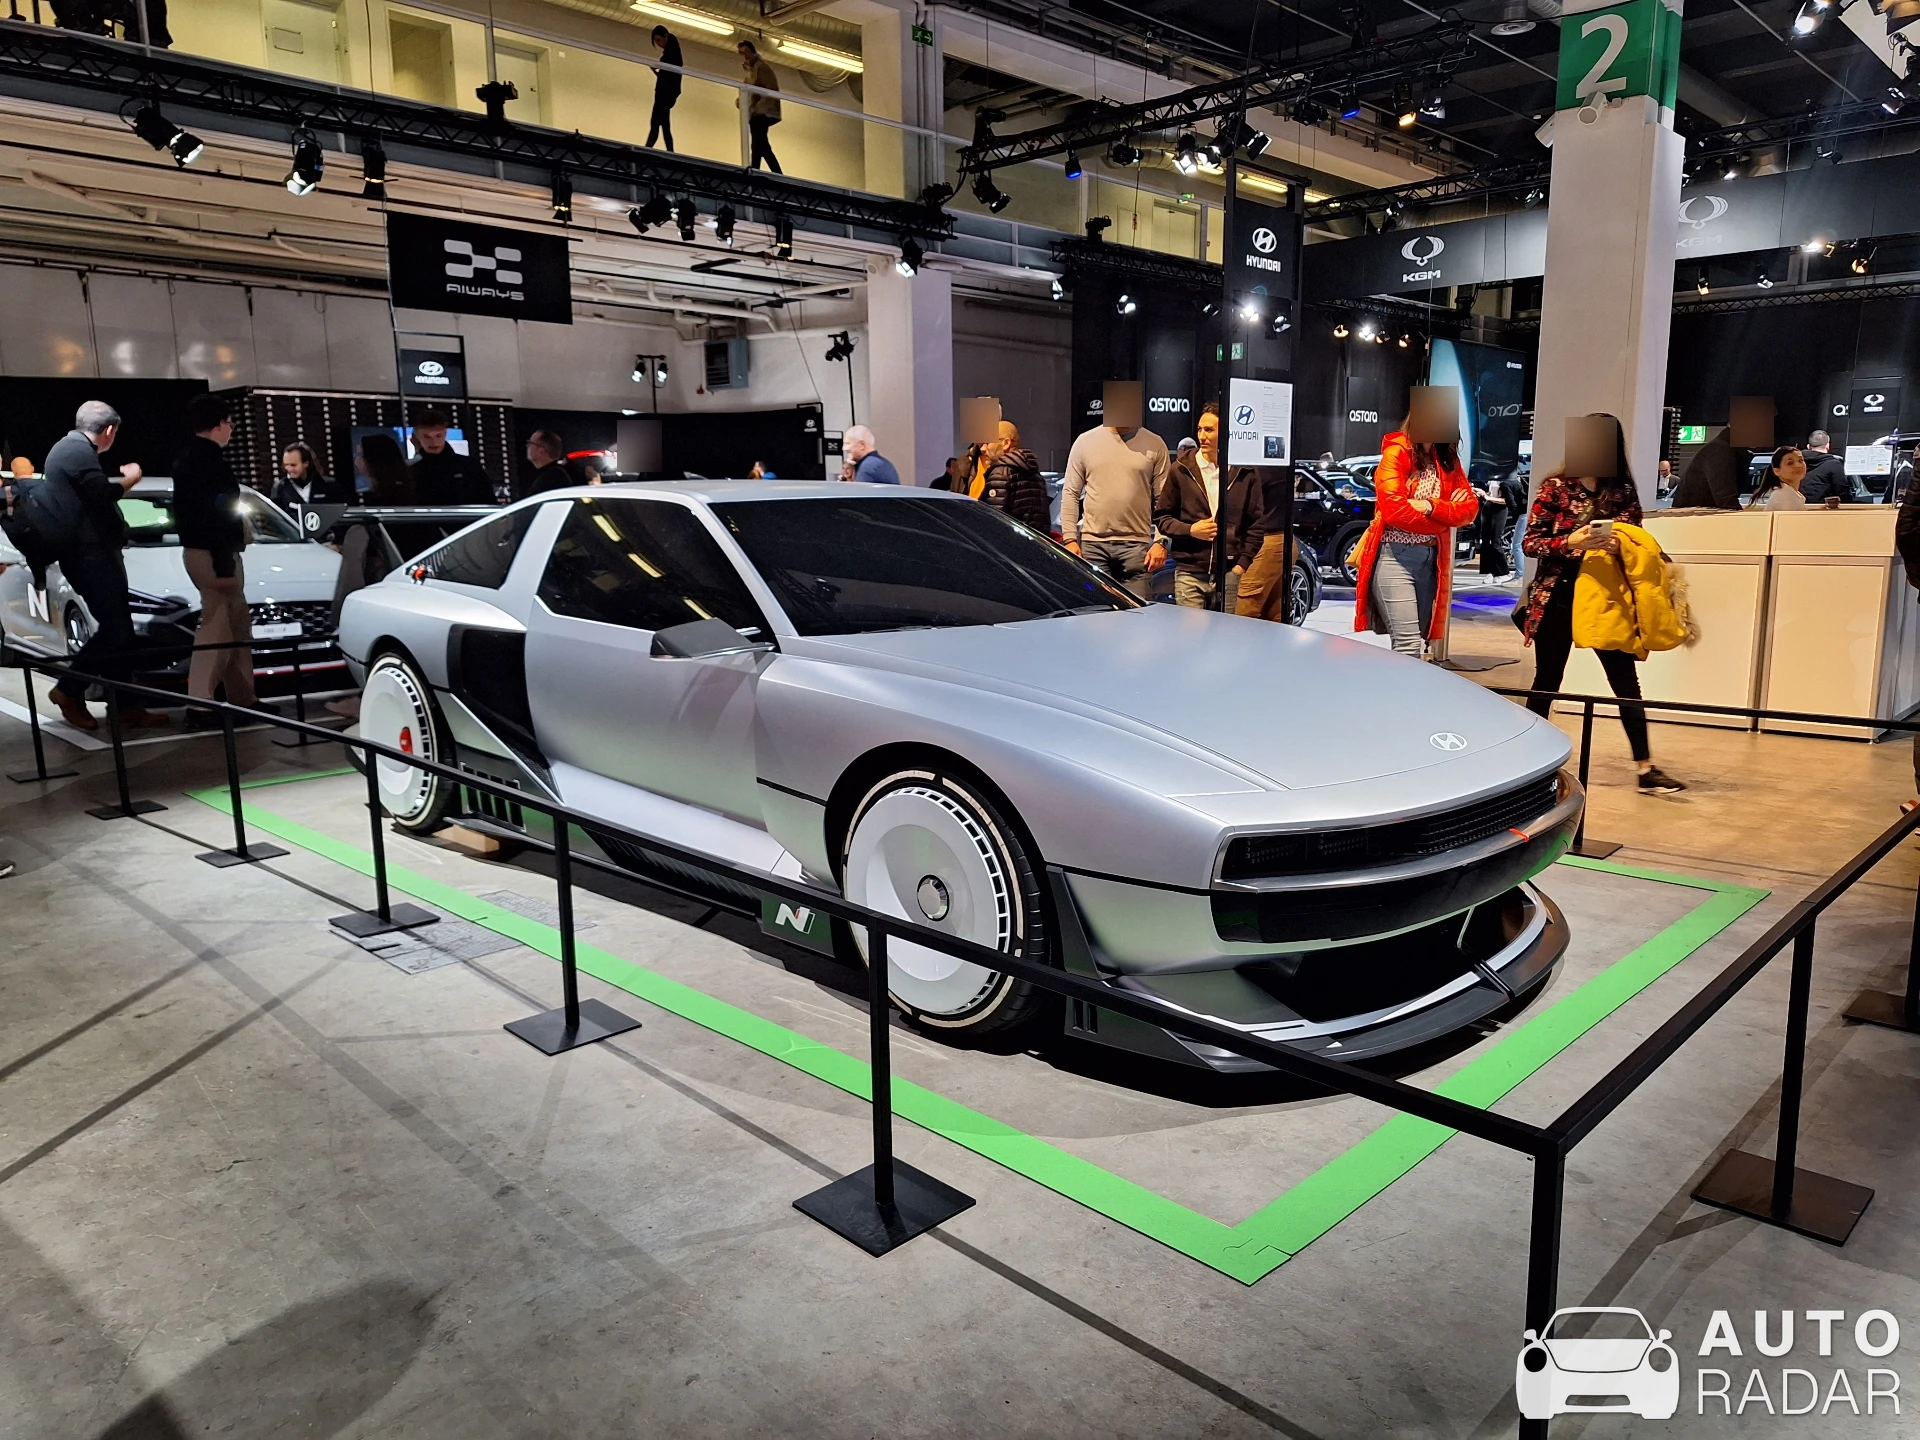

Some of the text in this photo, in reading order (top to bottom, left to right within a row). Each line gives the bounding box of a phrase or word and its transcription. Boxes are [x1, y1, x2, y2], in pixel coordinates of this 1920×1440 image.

[1576, 14, 1628, 99] 2
[1675, 234, 1723, 249] KGM
[1246, 254, 1281, 273] HYUNDAI
[1402, 269, 1441, 283] KGM
[446, 283, 525, 301] AIWAYS
[1148, 397, 1190, 413] astara
[1349, 409, 1378, 423] astara
[1229, 430, 1259, 441] HYUNDAI
[27, 582, 50, 623] N
[774, 902, 816, 935] N
